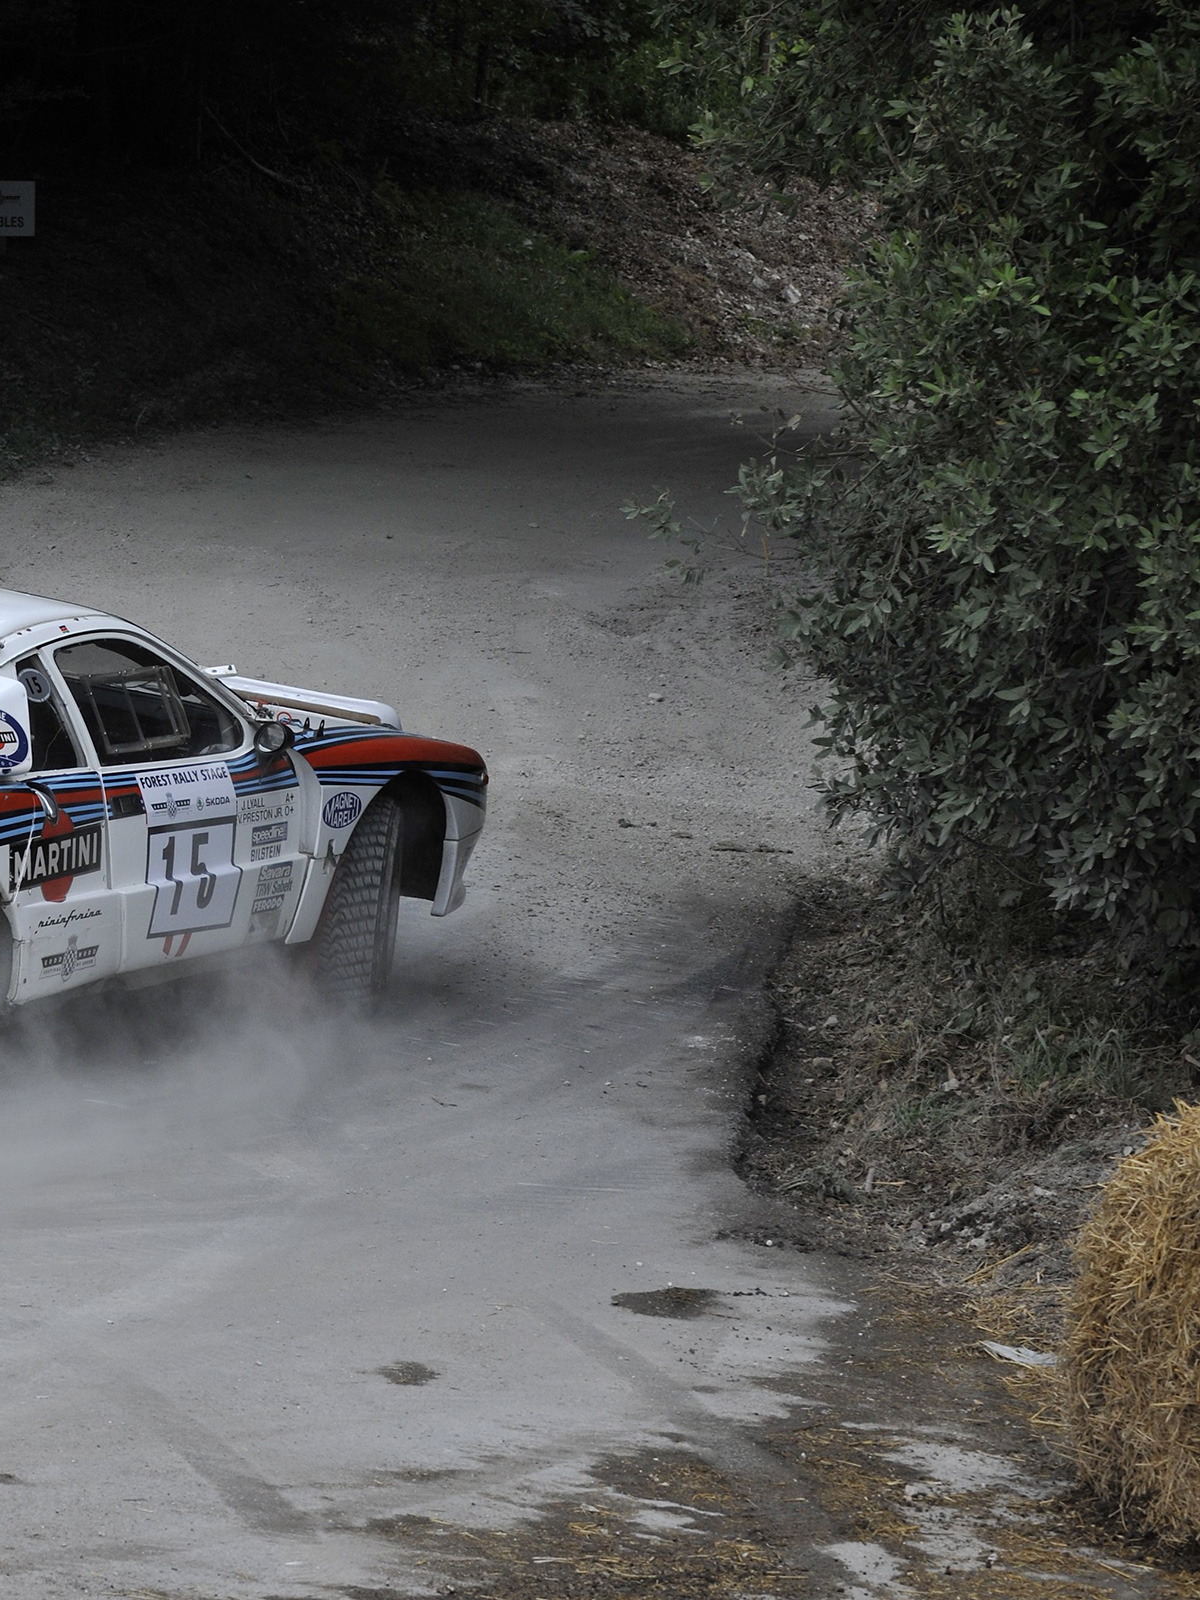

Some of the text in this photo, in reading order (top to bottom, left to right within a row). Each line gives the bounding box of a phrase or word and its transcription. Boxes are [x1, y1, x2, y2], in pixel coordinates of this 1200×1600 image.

[25, 676, 42, 695] 15
[140, 766, 228, 789] FOREST RALLY STAGE
[205, 796, 231, 807] ŠKODA
[253, 825, 284, 844] speedline
[13, 832, 98, 883] MARTINI
[251, 844, 281, 862] BILSTEIN
[162, 832, 217, 915] 15
[253, 897, 283, 913] FERODO
